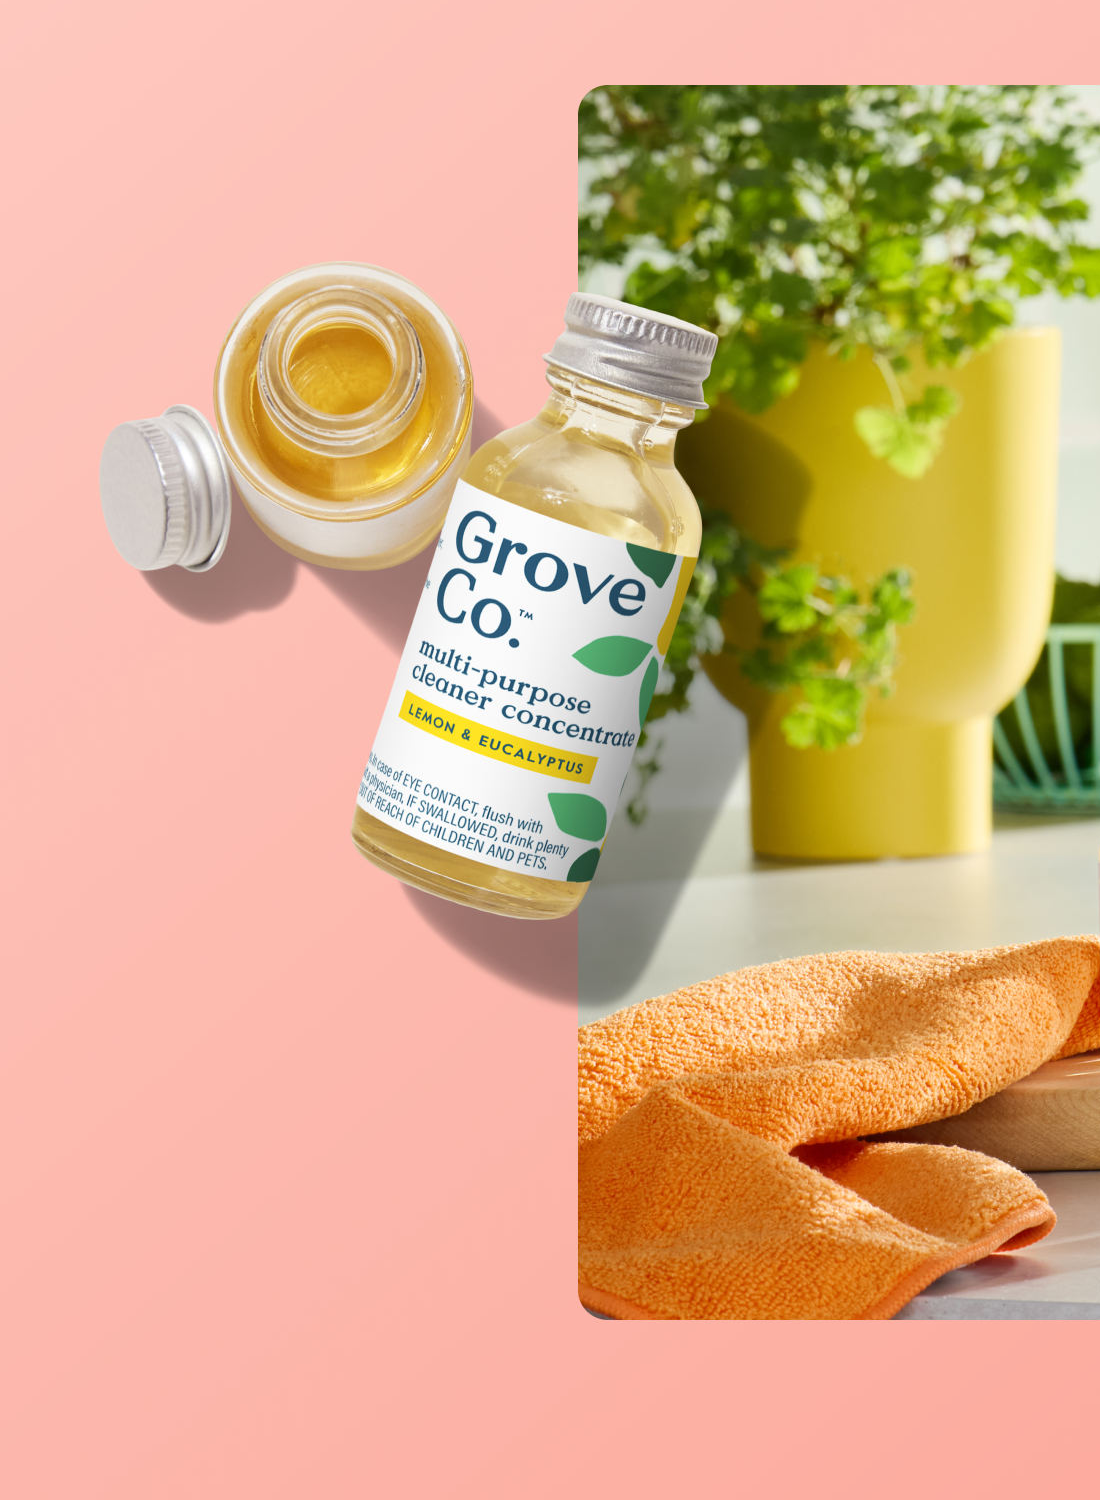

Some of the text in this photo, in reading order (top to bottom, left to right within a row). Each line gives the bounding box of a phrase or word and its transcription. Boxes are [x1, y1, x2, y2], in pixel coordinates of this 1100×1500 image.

[455, 510, 647, 617] Grove
[412, 664, 636, 748] cleaner concentrate
[418, 640, 592, 715] multi-purpose
[408, 703, 584, 775] LEMON & EUCALYPTUS
[366, 790, 377, 805] OF
[375, 796, 405, 822] REACH
[405, 812, 421, 828] OF
[421, 820, 485, 854] CHILDREN
[486, 844, 515, 862] AND
[516, 852, 547, 871] PETS.
[369, 773, 404, 804] physician.
[406, 794, 418, 808] IF
[418, 799, 498, 842] SWALLOWED,
[502, 830, 535, 850] drink
[534, 839, 570, 860] plenty
[376, 759, 393, 778] case
[393, 770, 404, 783] of
[402, 773, 423, 793] EYE
[423, 783, 480, 817] CONTACT,
[482, 805, 514, 827] flush
[517, 818, 543, 835] with
